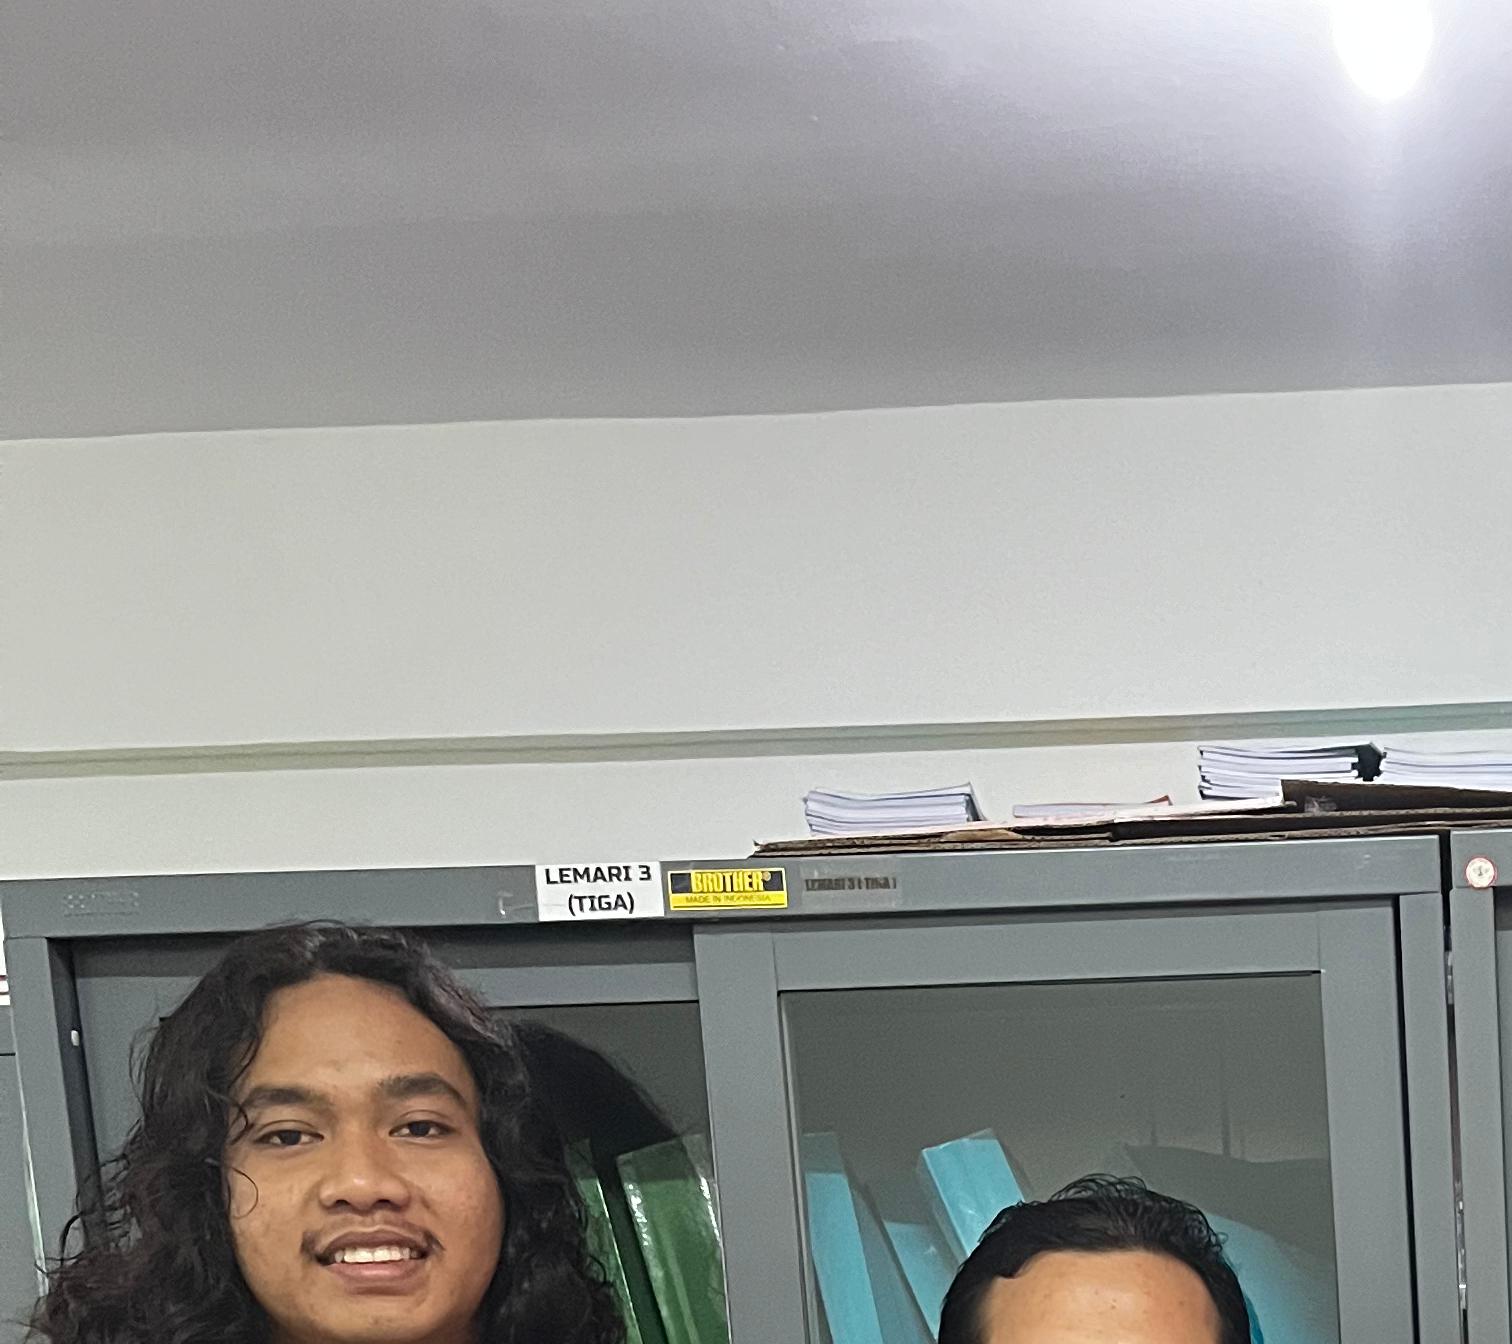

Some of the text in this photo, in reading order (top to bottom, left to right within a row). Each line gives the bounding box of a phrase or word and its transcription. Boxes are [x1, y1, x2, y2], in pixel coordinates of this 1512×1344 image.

[545, 865, 651, 885] LEMARI 3
[691, 871, 764, 893] BROTHER
[568, 893, 636, 916] (TIGA)
